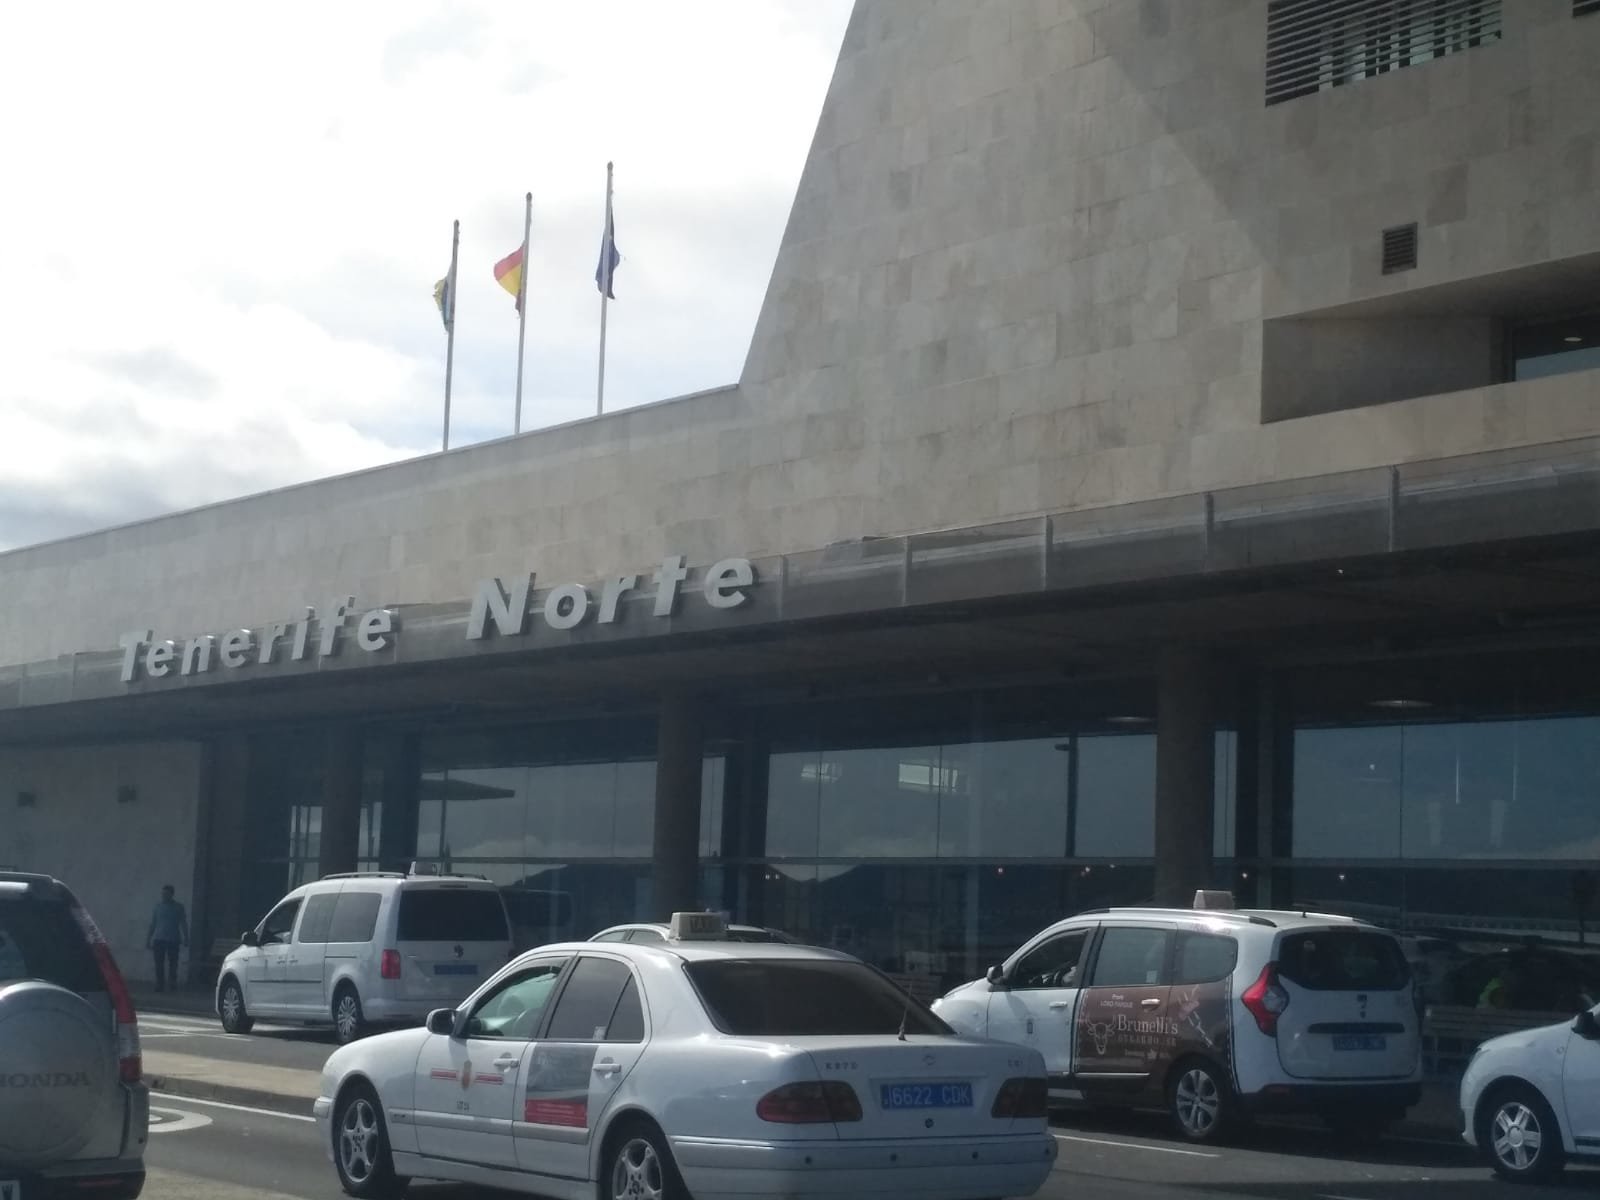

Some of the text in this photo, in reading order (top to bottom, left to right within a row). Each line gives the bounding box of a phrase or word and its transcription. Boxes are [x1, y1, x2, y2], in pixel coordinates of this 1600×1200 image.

[119, 555, 758, 682] Tenerife Norte
[1117, 1014, 1179, 1035] Brunelli's
[891, 1086, 933, 1106] 6622
